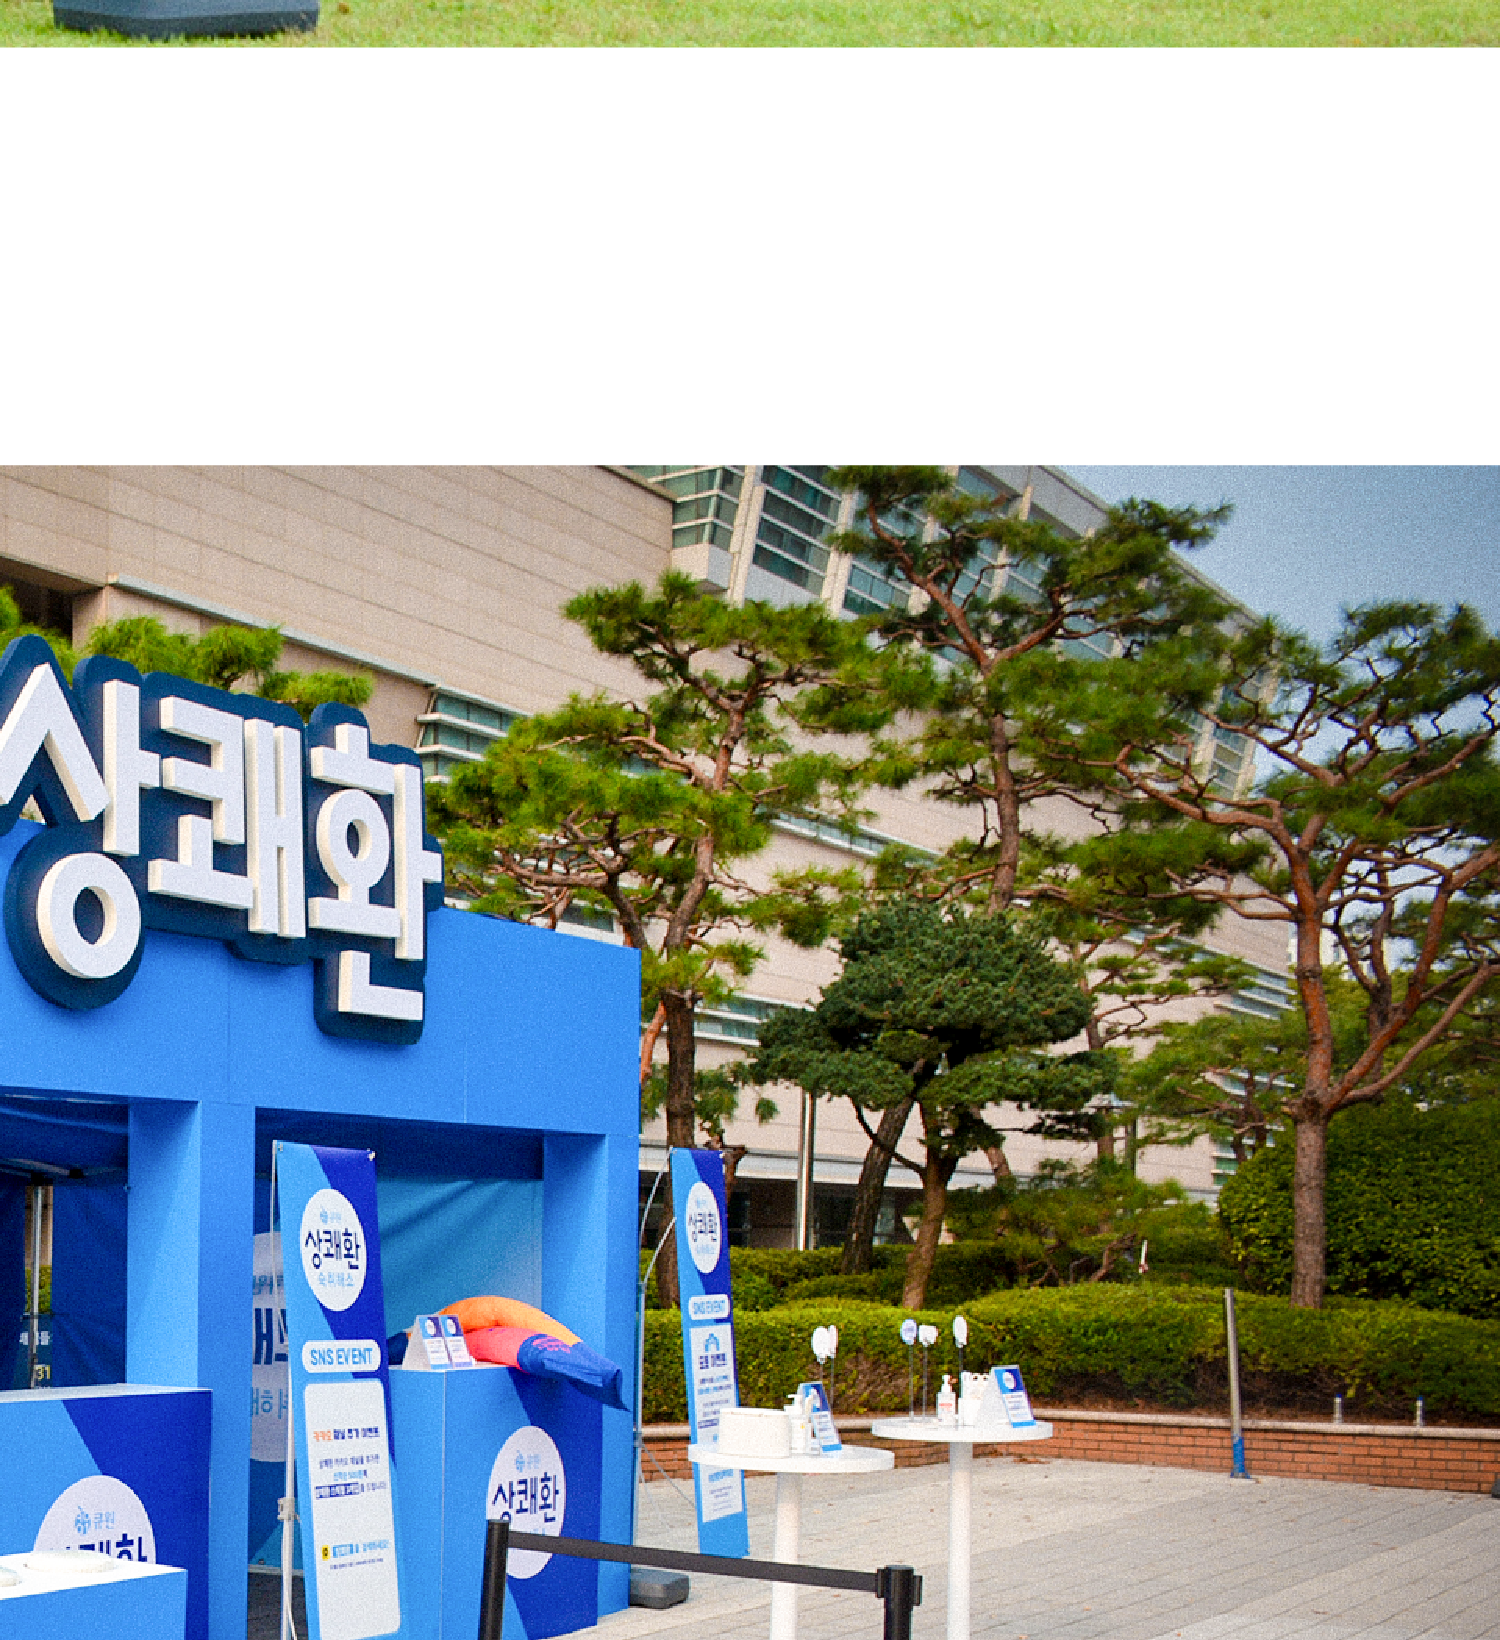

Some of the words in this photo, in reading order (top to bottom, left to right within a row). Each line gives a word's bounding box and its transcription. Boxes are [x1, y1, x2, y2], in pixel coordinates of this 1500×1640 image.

[305, 1228, 361, 1269] 상쾌환
[311, 1348, 333, 1365] SNS
[336, 1347, 372, 1364] EVENT
[492, 1472, 559, 1523] 상쾌환
